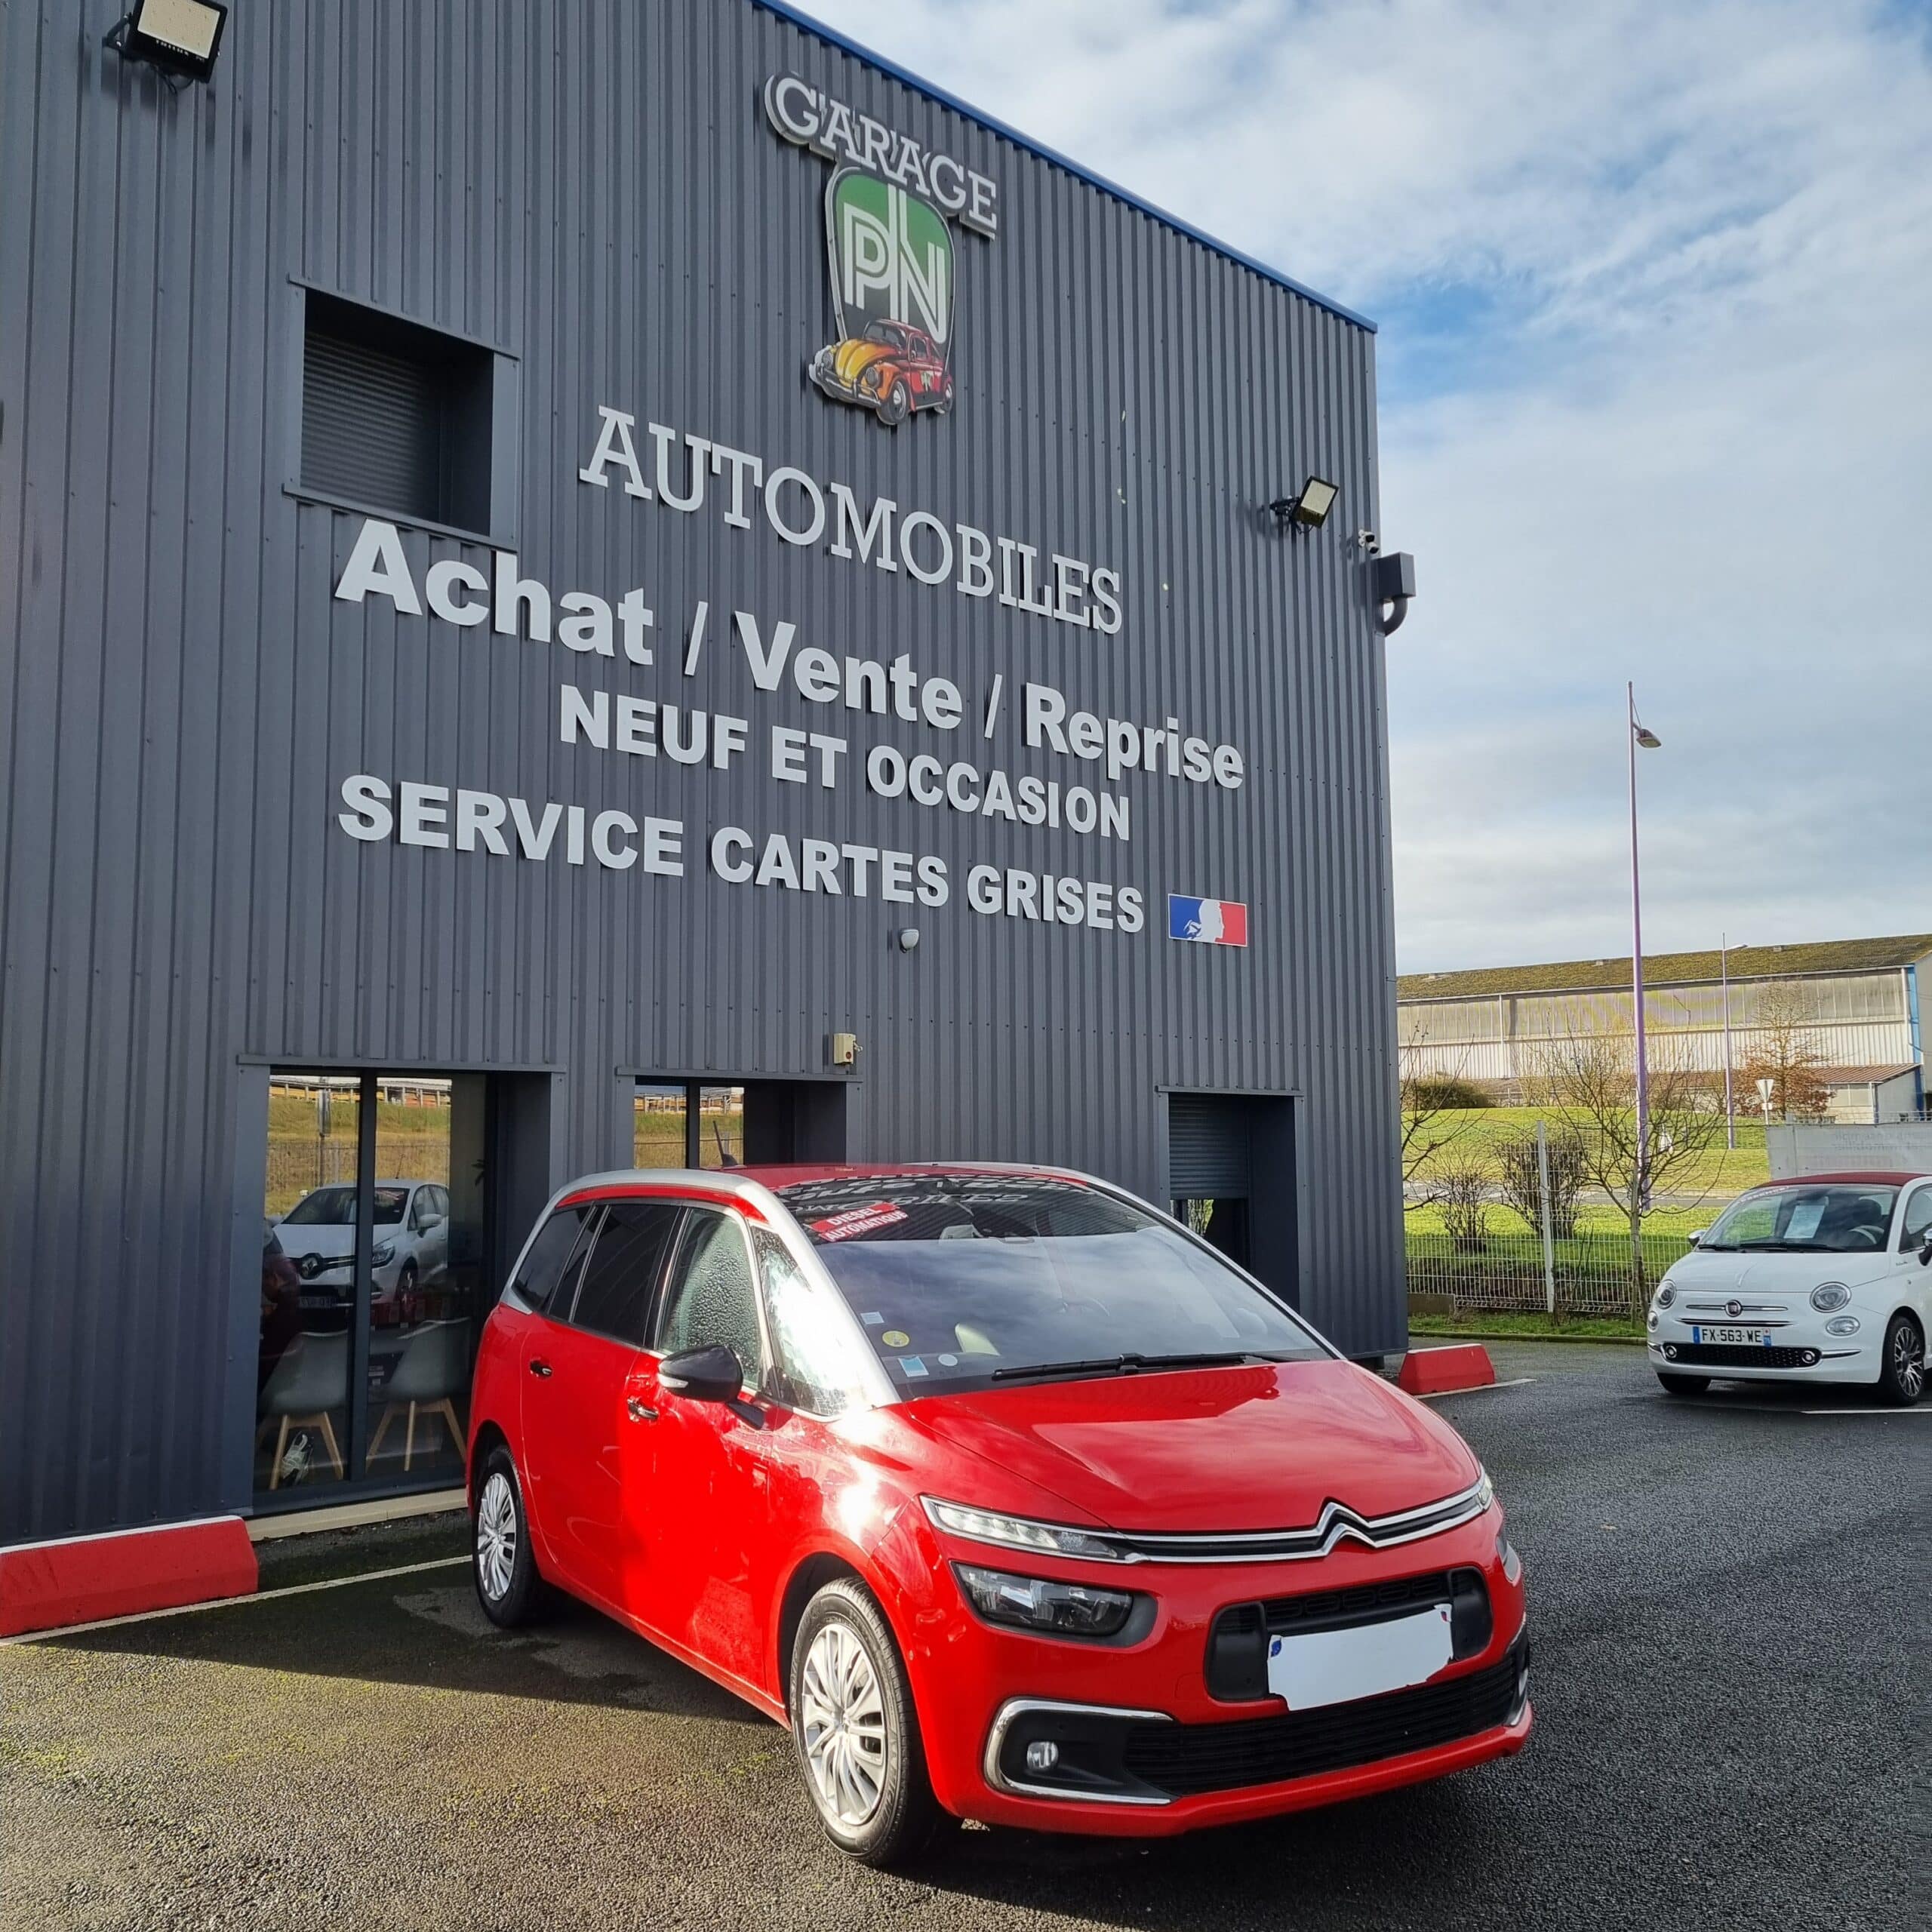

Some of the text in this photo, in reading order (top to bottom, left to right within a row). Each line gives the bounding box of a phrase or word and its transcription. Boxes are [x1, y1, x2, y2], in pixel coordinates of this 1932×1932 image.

[774, 76, 997, 231] GARAGE
[579, 405, 1122, 635] AUTOMOBILES
[334, 518, 1244, 789] Achat / Vente / Reprise
[560, 684, 1130, 841] NEUF ET OCCASION
[338, 774, 1144, 933] SERVICE CARTES GRISES
[824, 1210, 909, 1241] AUTOMATIQUE
[827, 1208, 883, 1226] DIESEL
[1701, 1328, 1763, 1343] FX-563-WE
